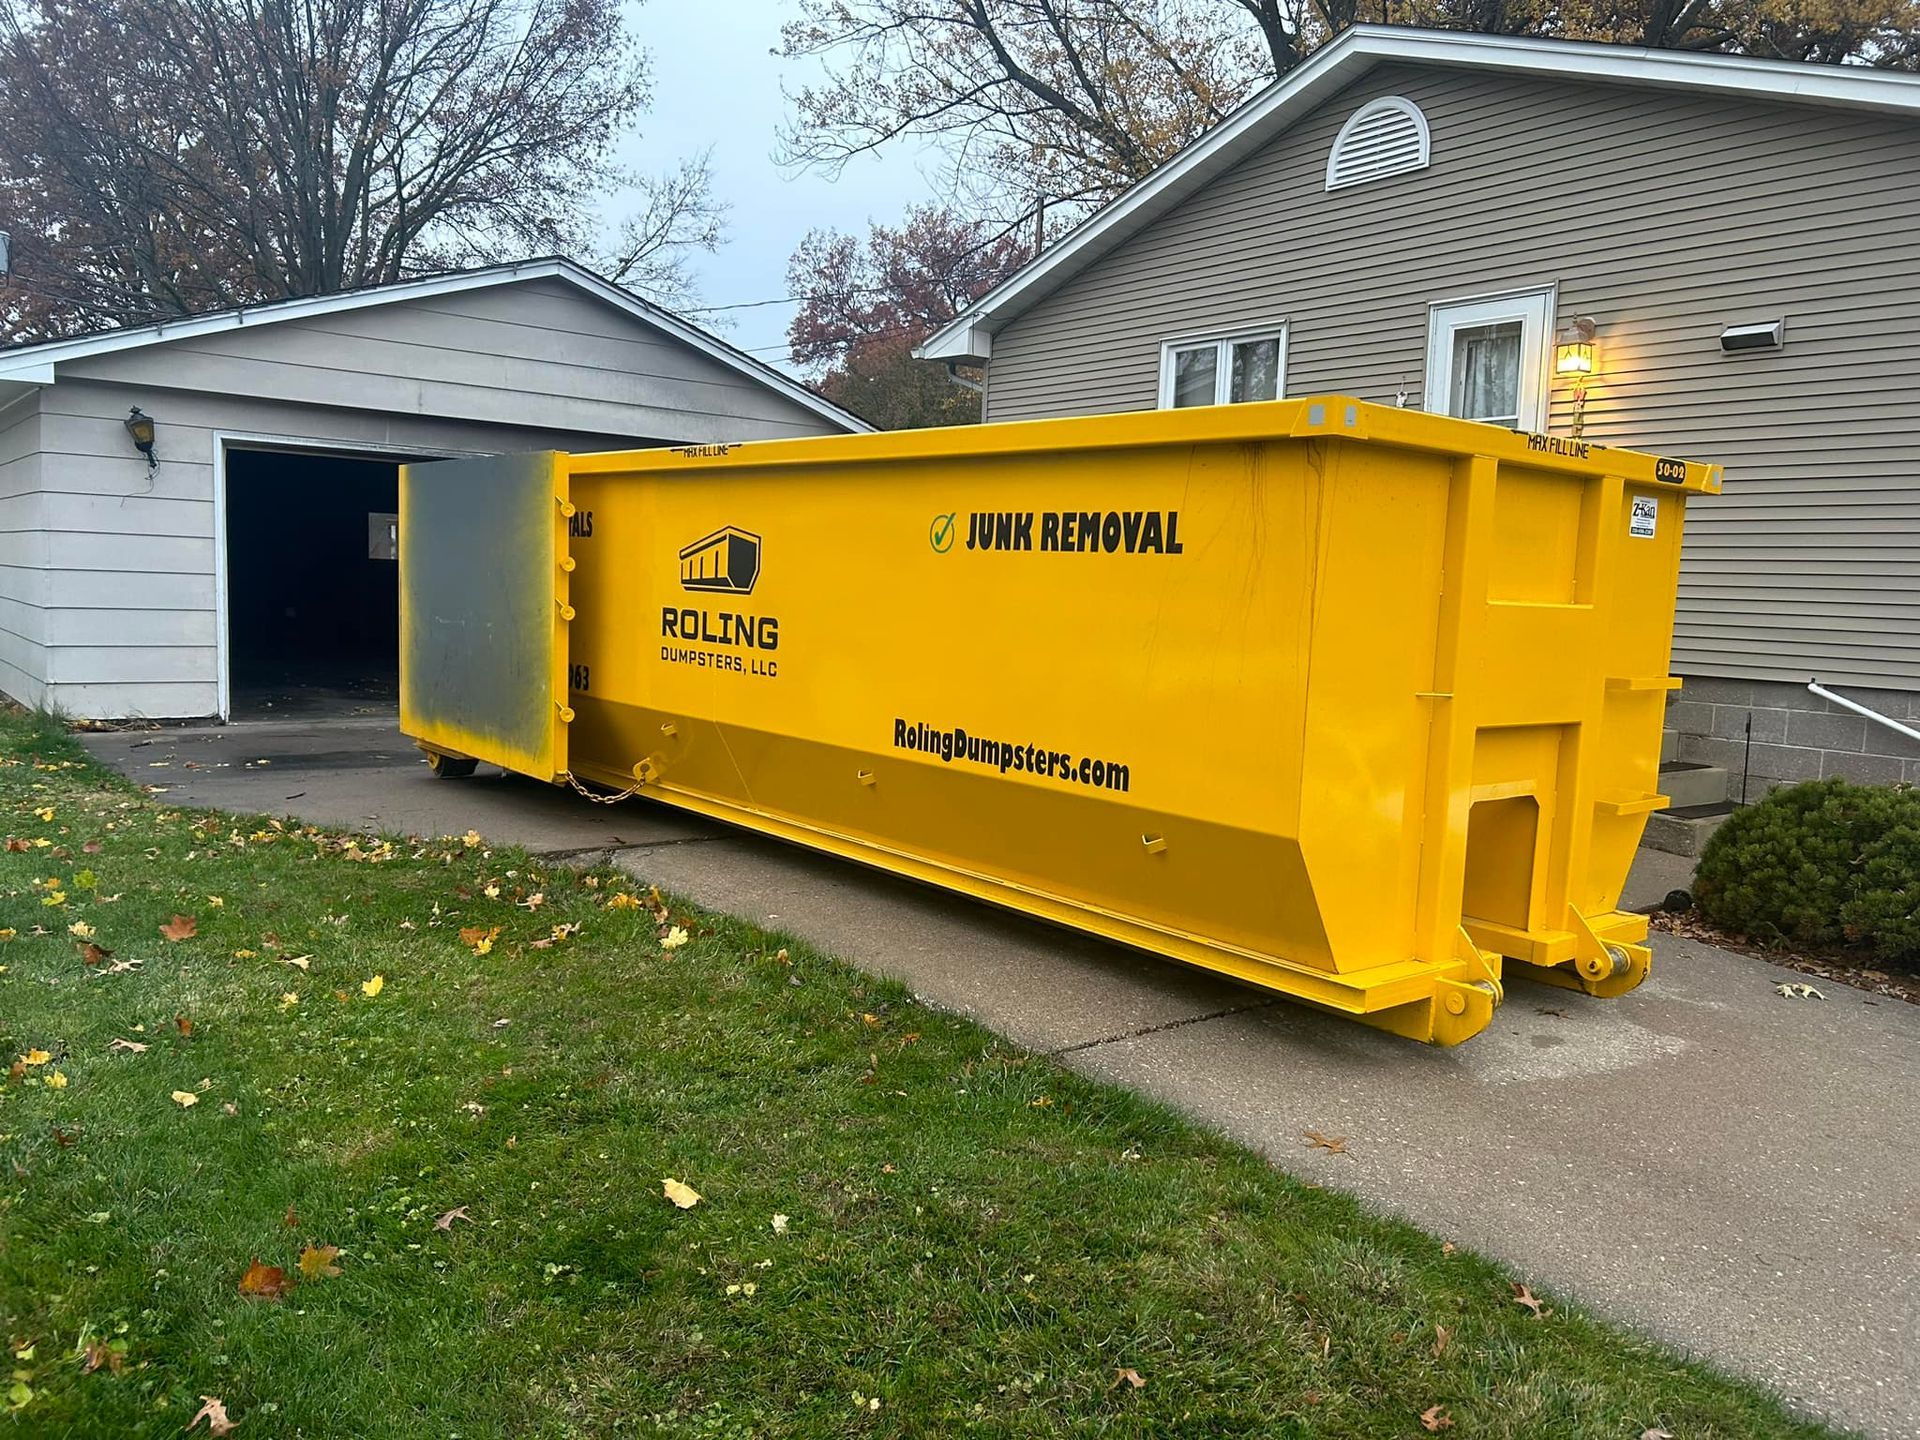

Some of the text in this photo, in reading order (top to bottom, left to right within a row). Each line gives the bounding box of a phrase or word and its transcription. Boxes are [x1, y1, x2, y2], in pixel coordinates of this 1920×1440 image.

[683, 444, 728, 458] MAX FILL LINE
[1528, 434, 1589, 459] MAX FILL LINE
[1657, 462, 1685, 479] 30-02
[966, 511, 1184, 555] JUNK REMOVAL
[662, 607, 779, 650] ROLING
[661, 646, 778, 677] DUMPSTERS, LLC
[893, 718, 1130, 792] RolingDumpsters.com
